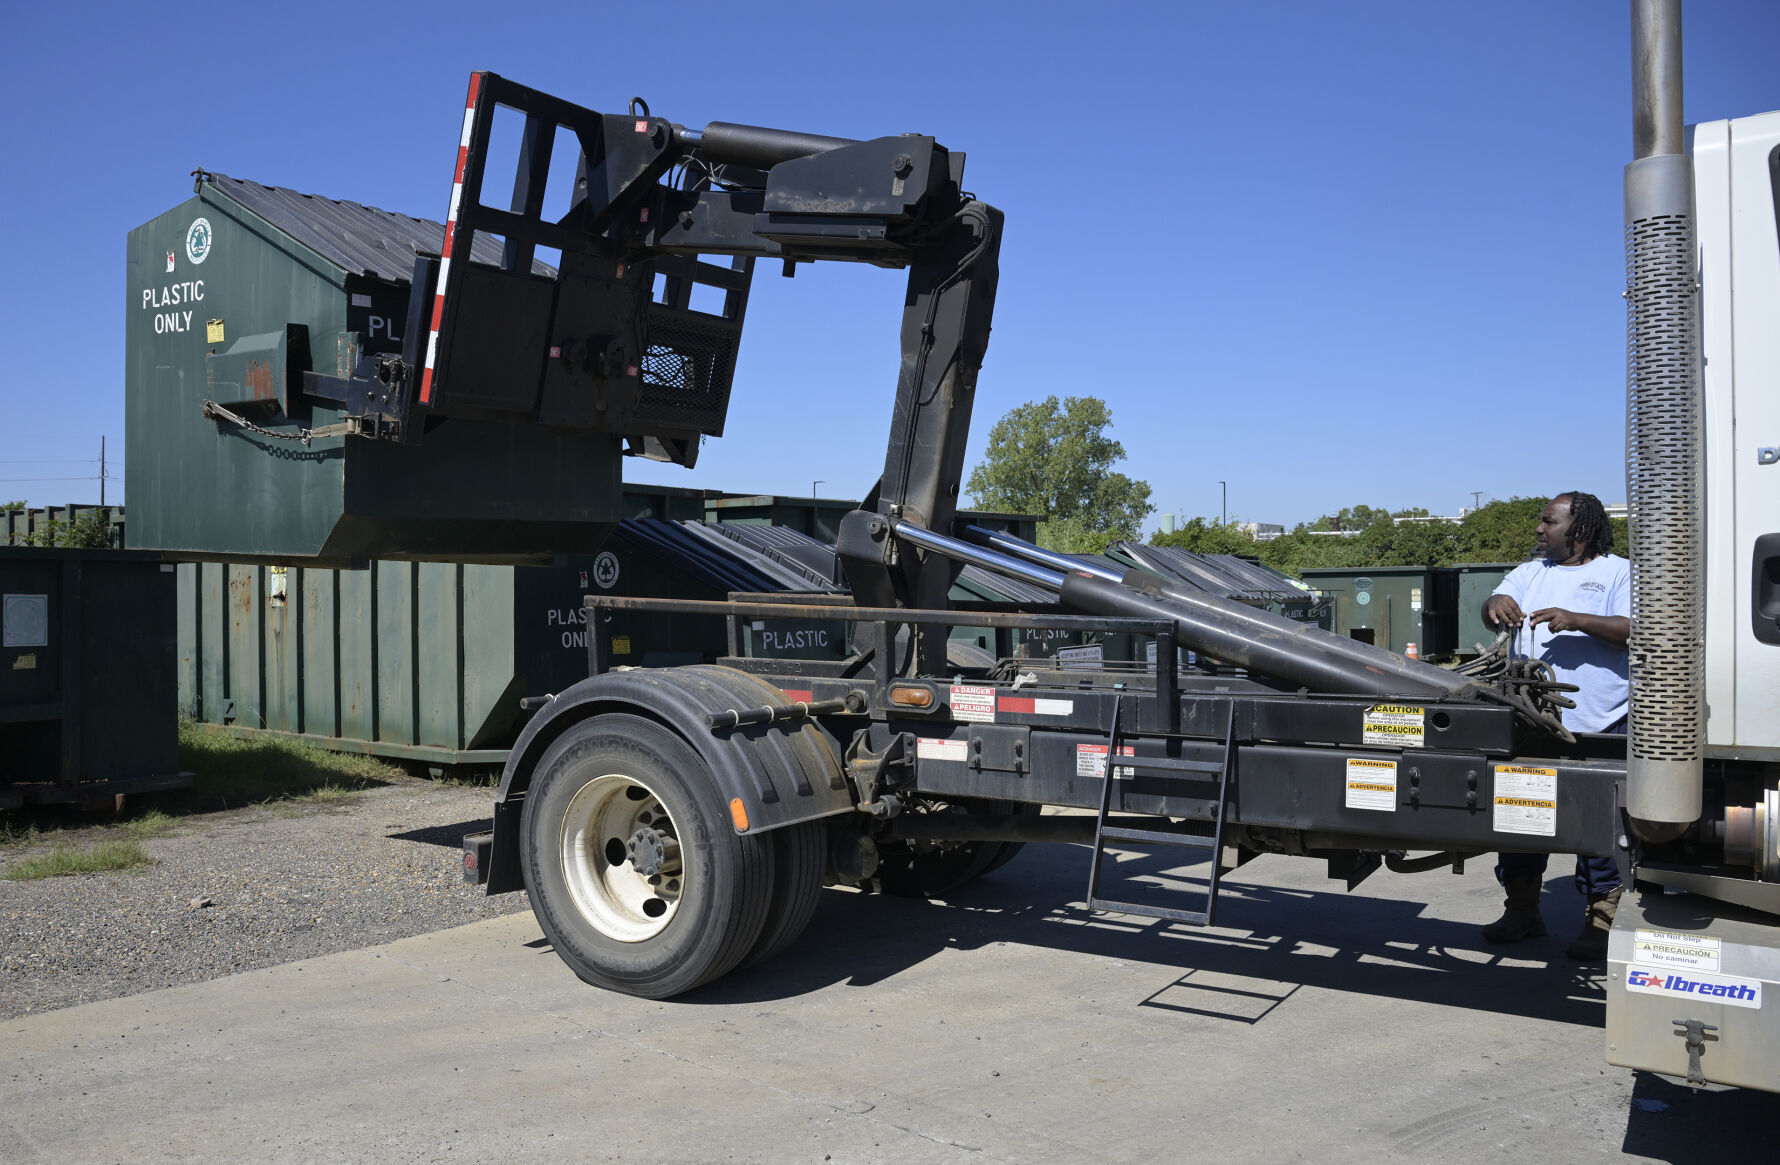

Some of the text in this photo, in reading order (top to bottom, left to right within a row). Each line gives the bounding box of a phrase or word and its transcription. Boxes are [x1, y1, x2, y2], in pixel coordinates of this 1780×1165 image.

[143, 280, 205, 309] PLASTIC
[154, 311, 193, 334] ONLY
[368, 315, 401, 341] PL
[1026, 628, 1069, 640] PLSTIC
[561, 631, 590, 649] ONL
[763, 630, 828, 650] PLASTIC
[961, 687, 991, 695] DANGER
[1376, 705, 1420, 714] CAUTION
[1373, 725, 1422, 734] PRECAUCION
[1504, 799, 1552, 807] ADVERTENCIA
[1683, 935, 1702, 943] Step
[1665, 955, 1698, 964] caminar
